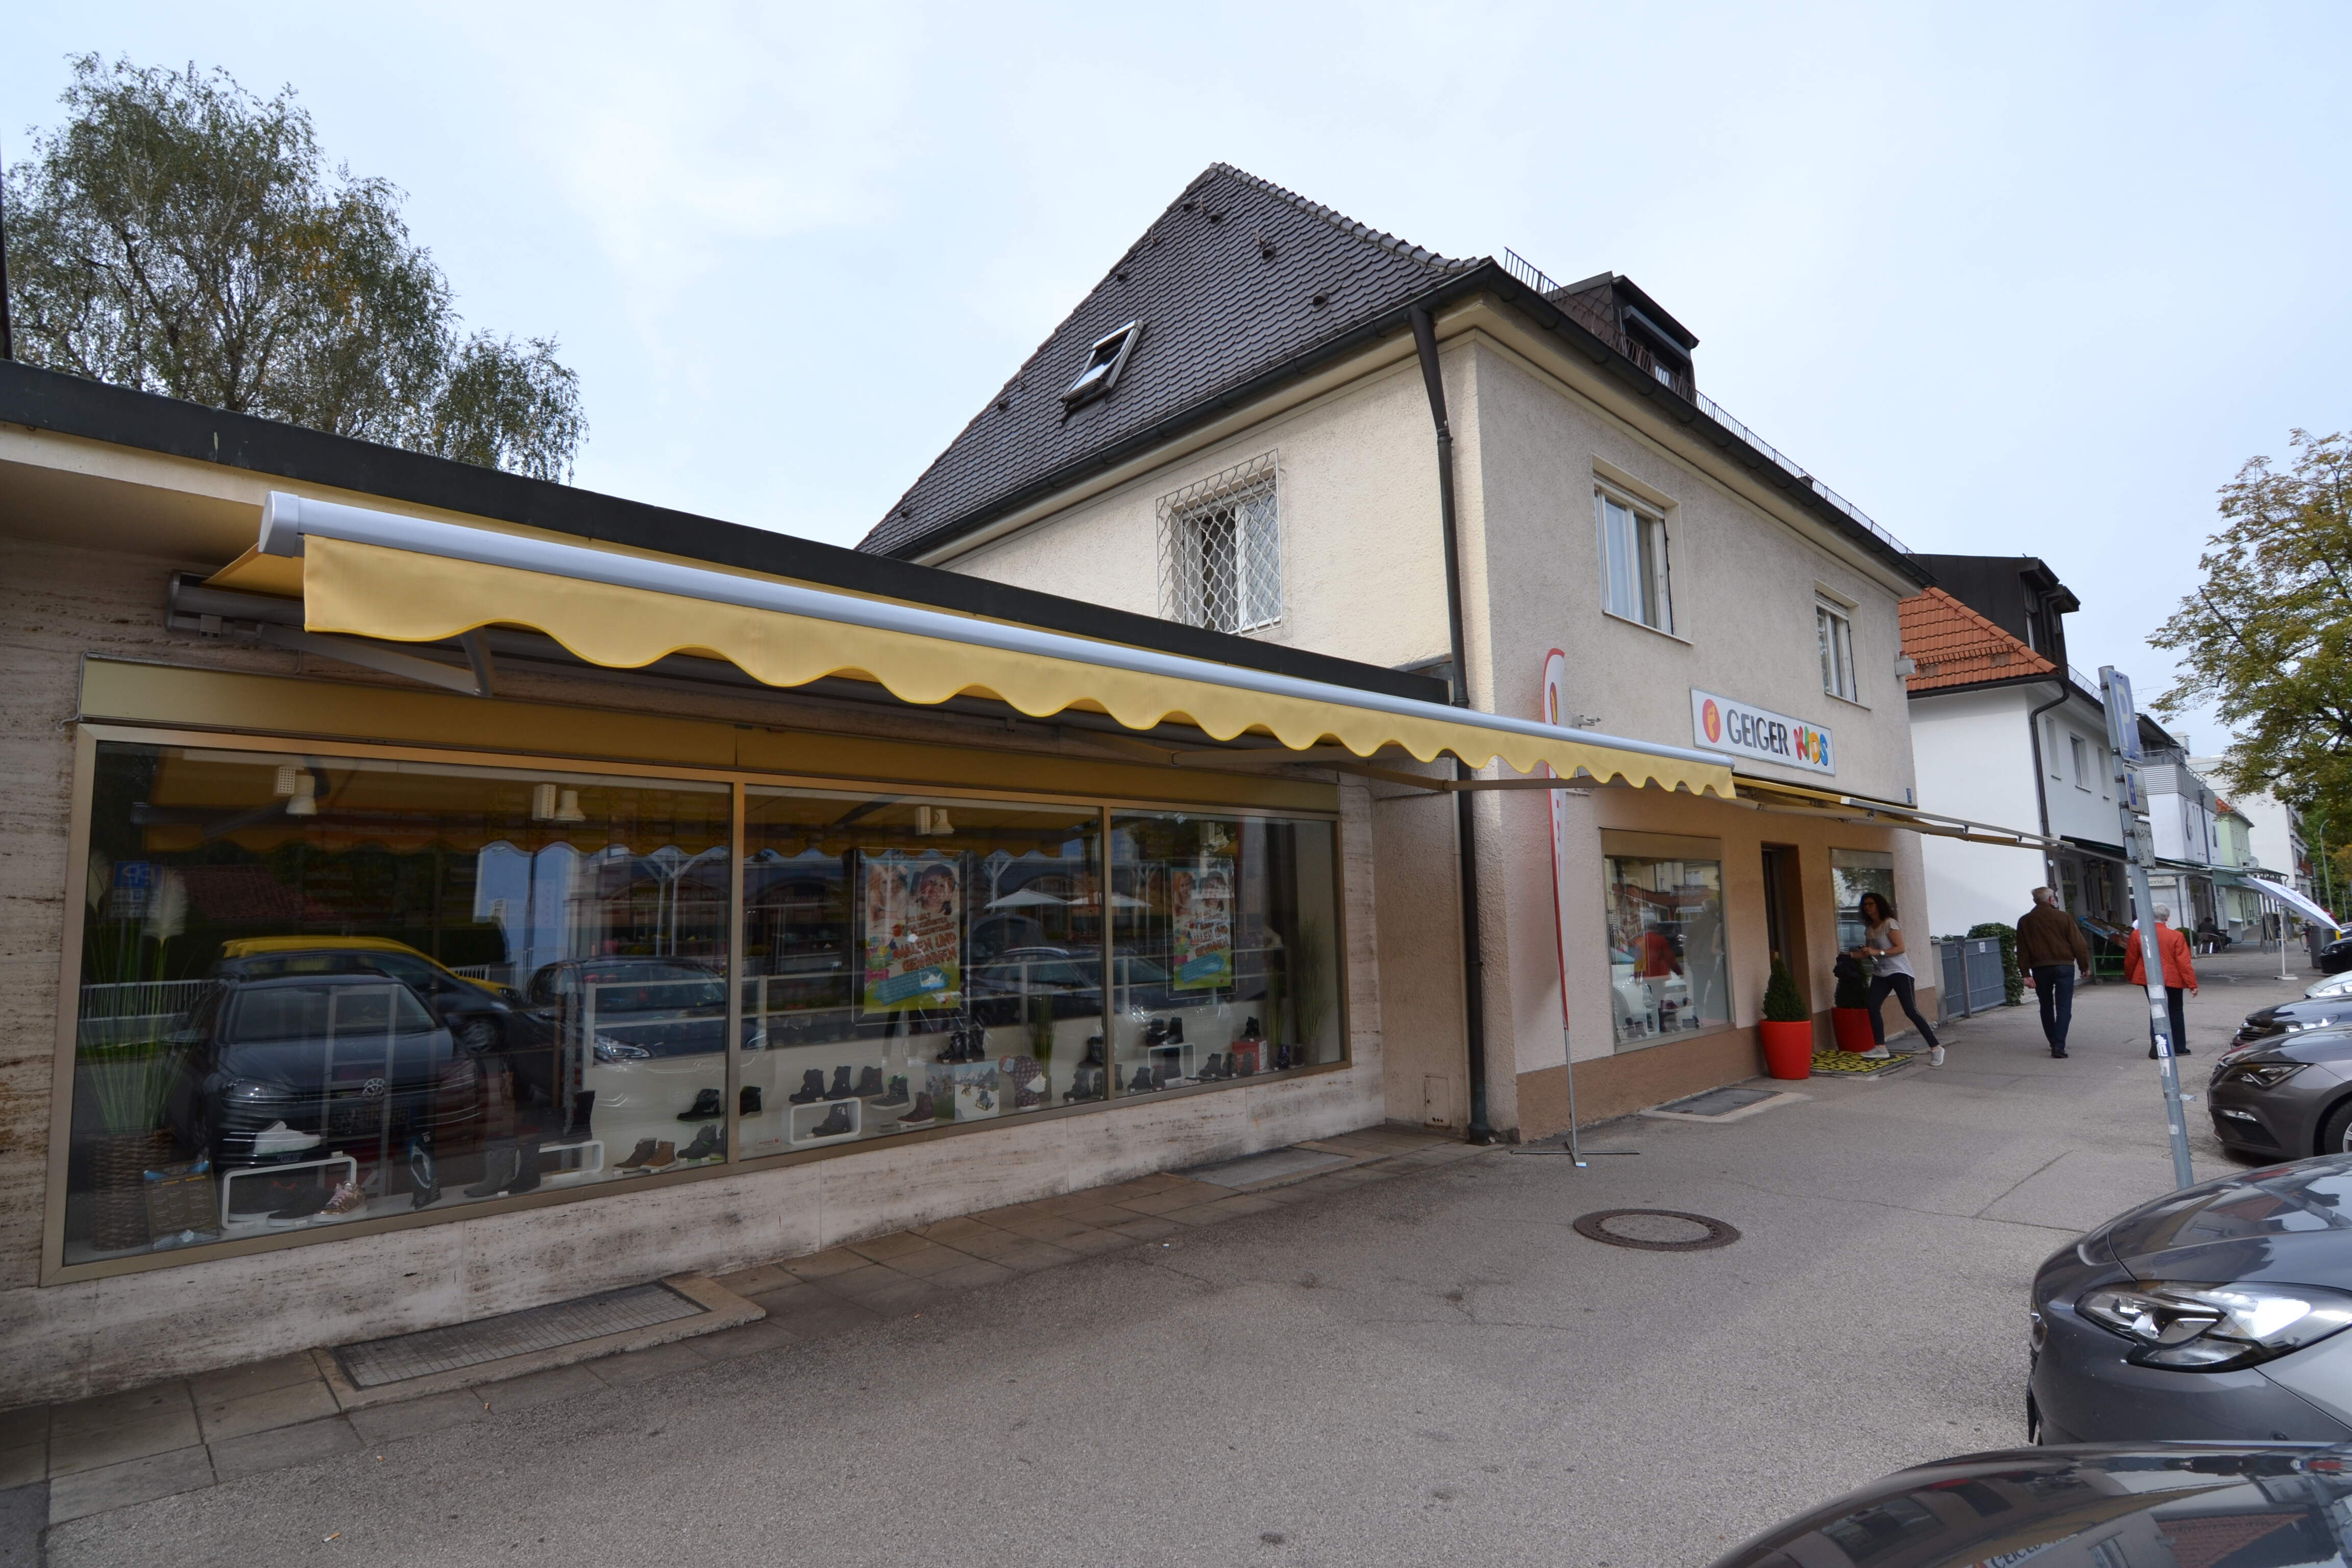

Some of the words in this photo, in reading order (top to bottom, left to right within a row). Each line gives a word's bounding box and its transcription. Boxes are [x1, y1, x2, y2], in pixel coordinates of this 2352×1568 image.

[1726, 708, 1791, 756] GEIGER
[1793, 725, 1829, 766] KIDS
[2115, 682, 2131, 749] P
[898, 937, 934, 959] MALEN
[935, 931, 957, 948] UND
[902, 946, 957, 971] GEWINNEN
